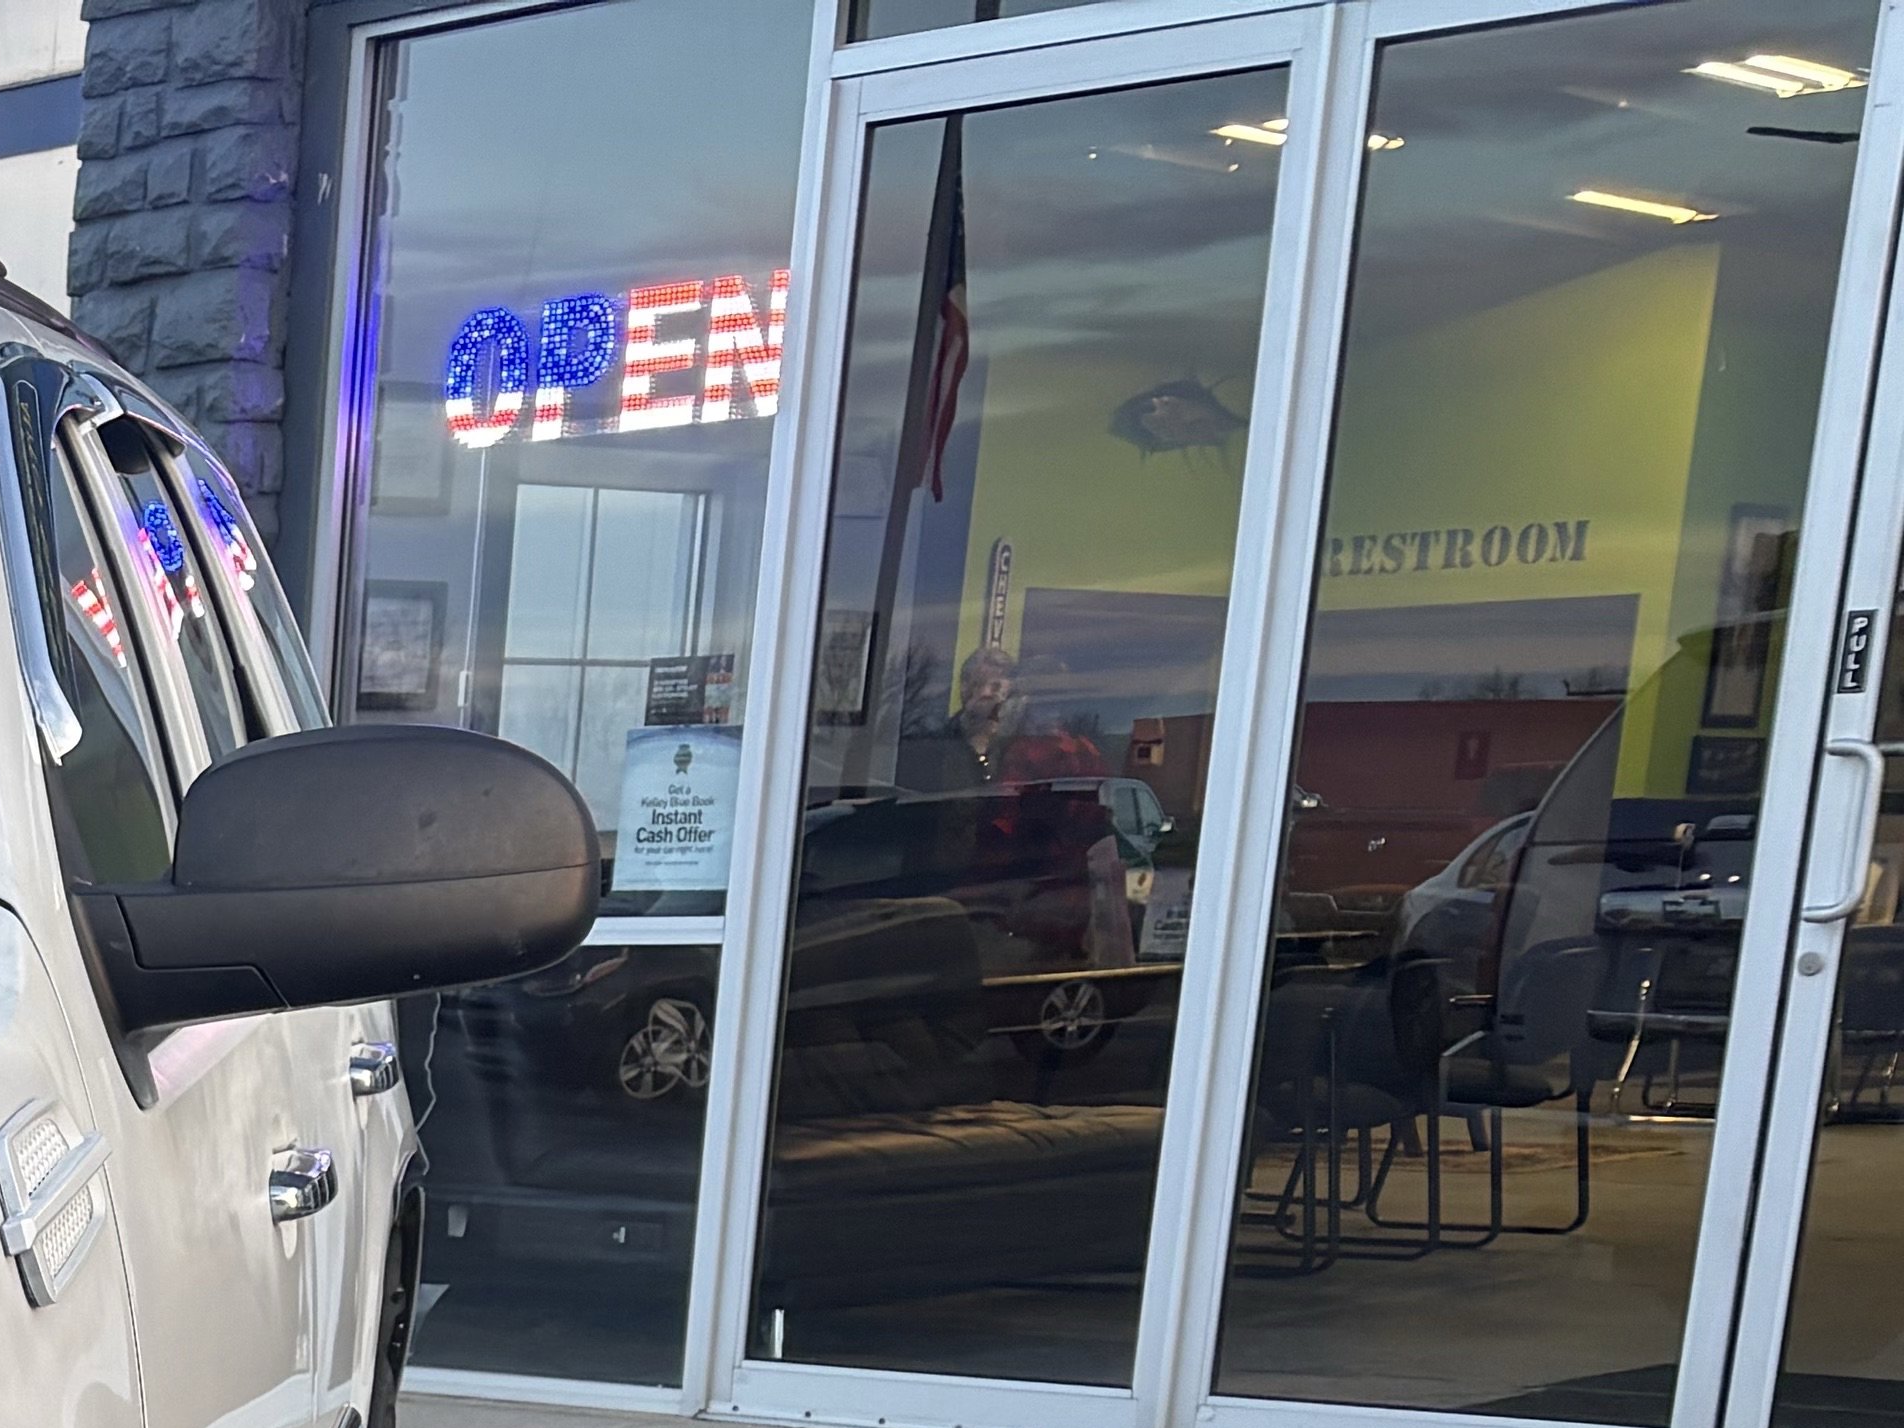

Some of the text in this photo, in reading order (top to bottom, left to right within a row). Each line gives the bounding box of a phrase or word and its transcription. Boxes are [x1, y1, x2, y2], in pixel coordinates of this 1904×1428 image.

[446, 268, 791, 450] OPEN
[1843, 616, 1868, 689] PULL
[636, 826, 715, 843] Cash Offer
[651, 808, 703, 825] Instant
